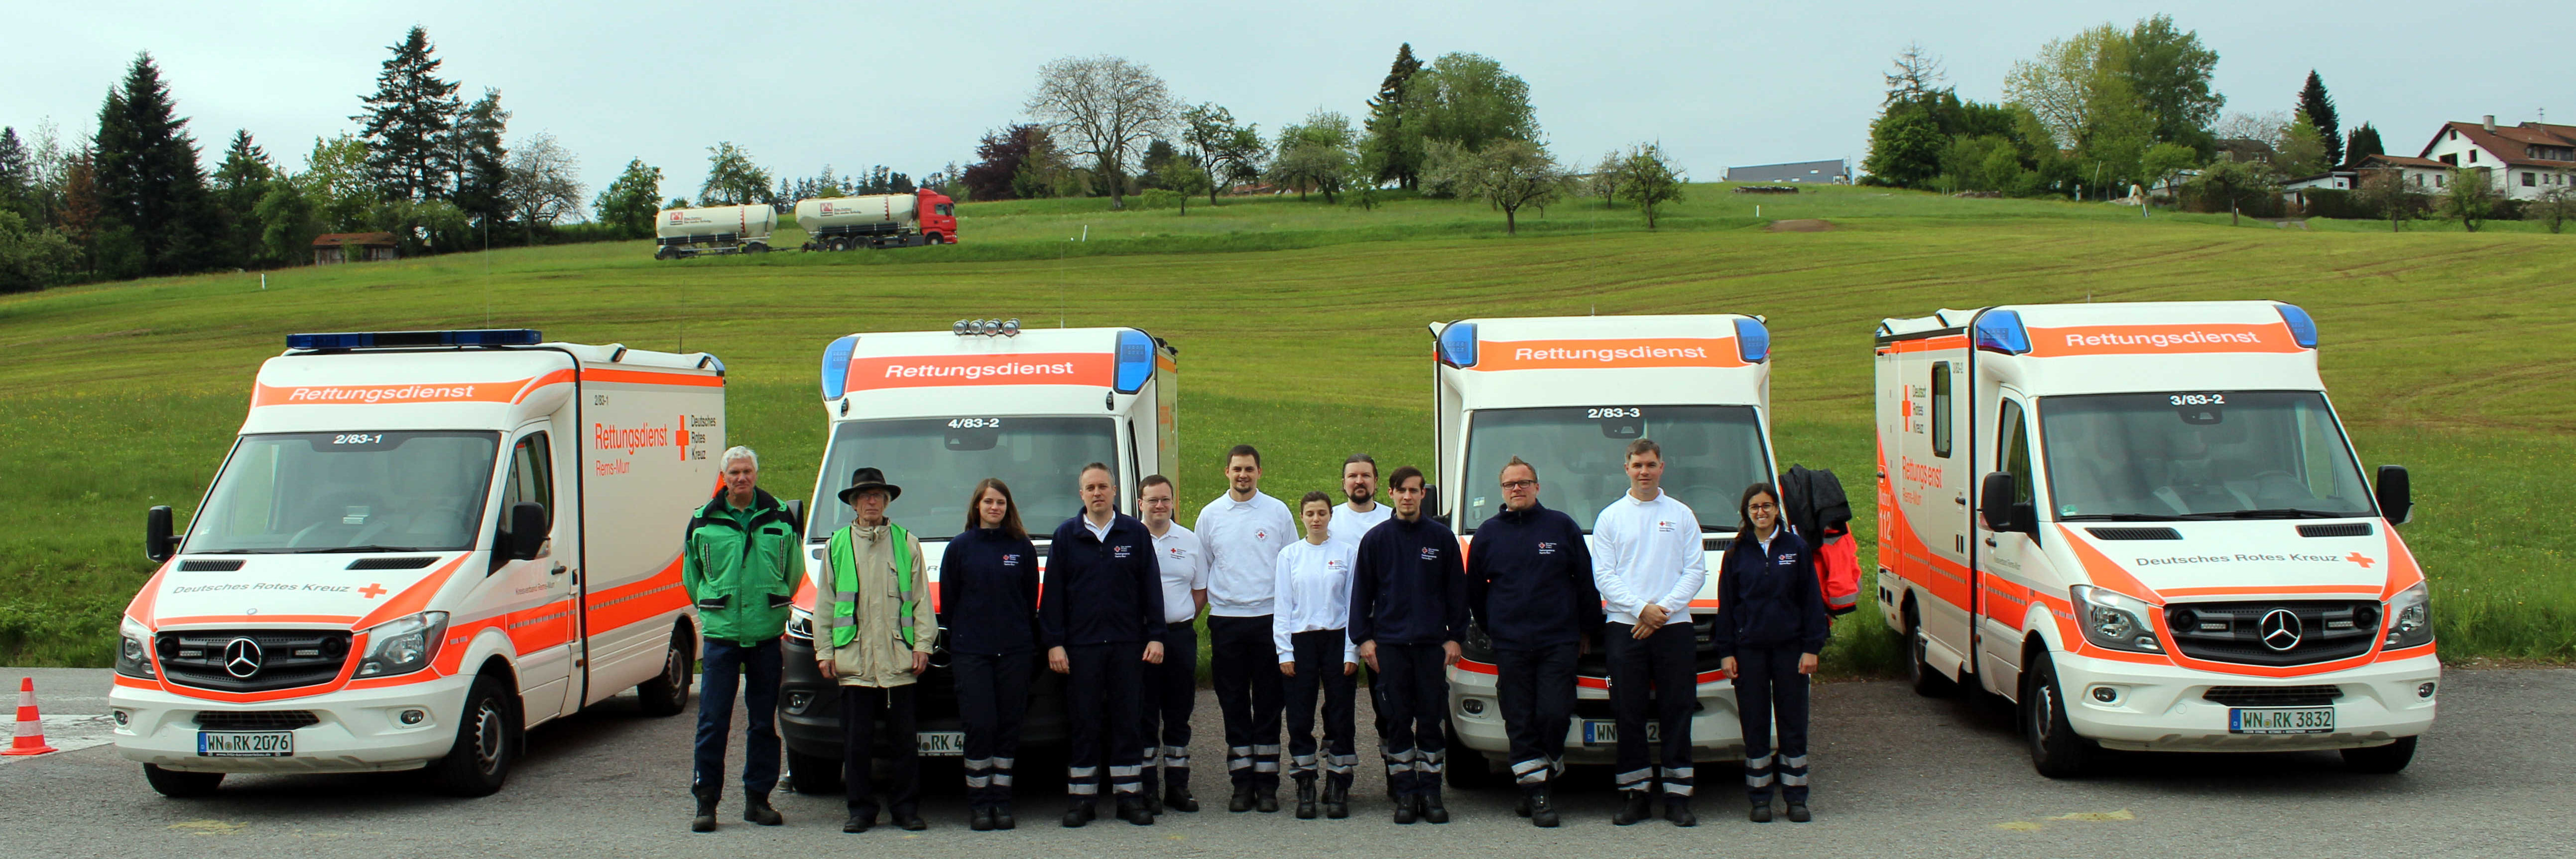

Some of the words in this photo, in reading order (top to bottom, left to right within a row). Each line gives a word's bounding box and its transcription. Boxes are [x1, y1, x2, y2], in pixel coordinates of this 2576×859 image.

[2066, 331, 2261, 347] Rettungsdienst
[1515, 346, 1707, 362] Rettungsdienst
[885, 362, 1074, 379] Rettungsdienst
[289, 385, 475, 403] Rettungsdienst
[2170, 394, 2224, 406] 3/83-2
[1587, 407, 1641, 419] 2/83-3
[691, 415, 716, 427] Deutsches
[948, 418, 1000, 429] 4/83-2
[333, 433, 383, 444] 2/83-1
[595, 422, 668, 455] Rettungsdienst
[691, 431, 706, 443] Rotes
[692, 448, 706, 460] Kreuz
[596, 458, 630, 476] Rems-Murr
[1879, 509, 1892, 540] 112
[2135, 554, 2230, 566] Deutsches
[2289, 553, 2339, 562] Kreuz
[173, 583, 249, 594] Deutsches
[301, 583, 351, 592] Kreuz
[2243, 712, 2262, 728] WN
[2273, 712, 2292, 728] RK
[2296, 711, 2331, 728] 3832
[1596, 725, 1616, 741] WN
[208, 735, 224, 750] WN
[234, 735, 250, 751] RK
[253, 735, 288, 751] 2076
[931, 735, 950, 750] RK
